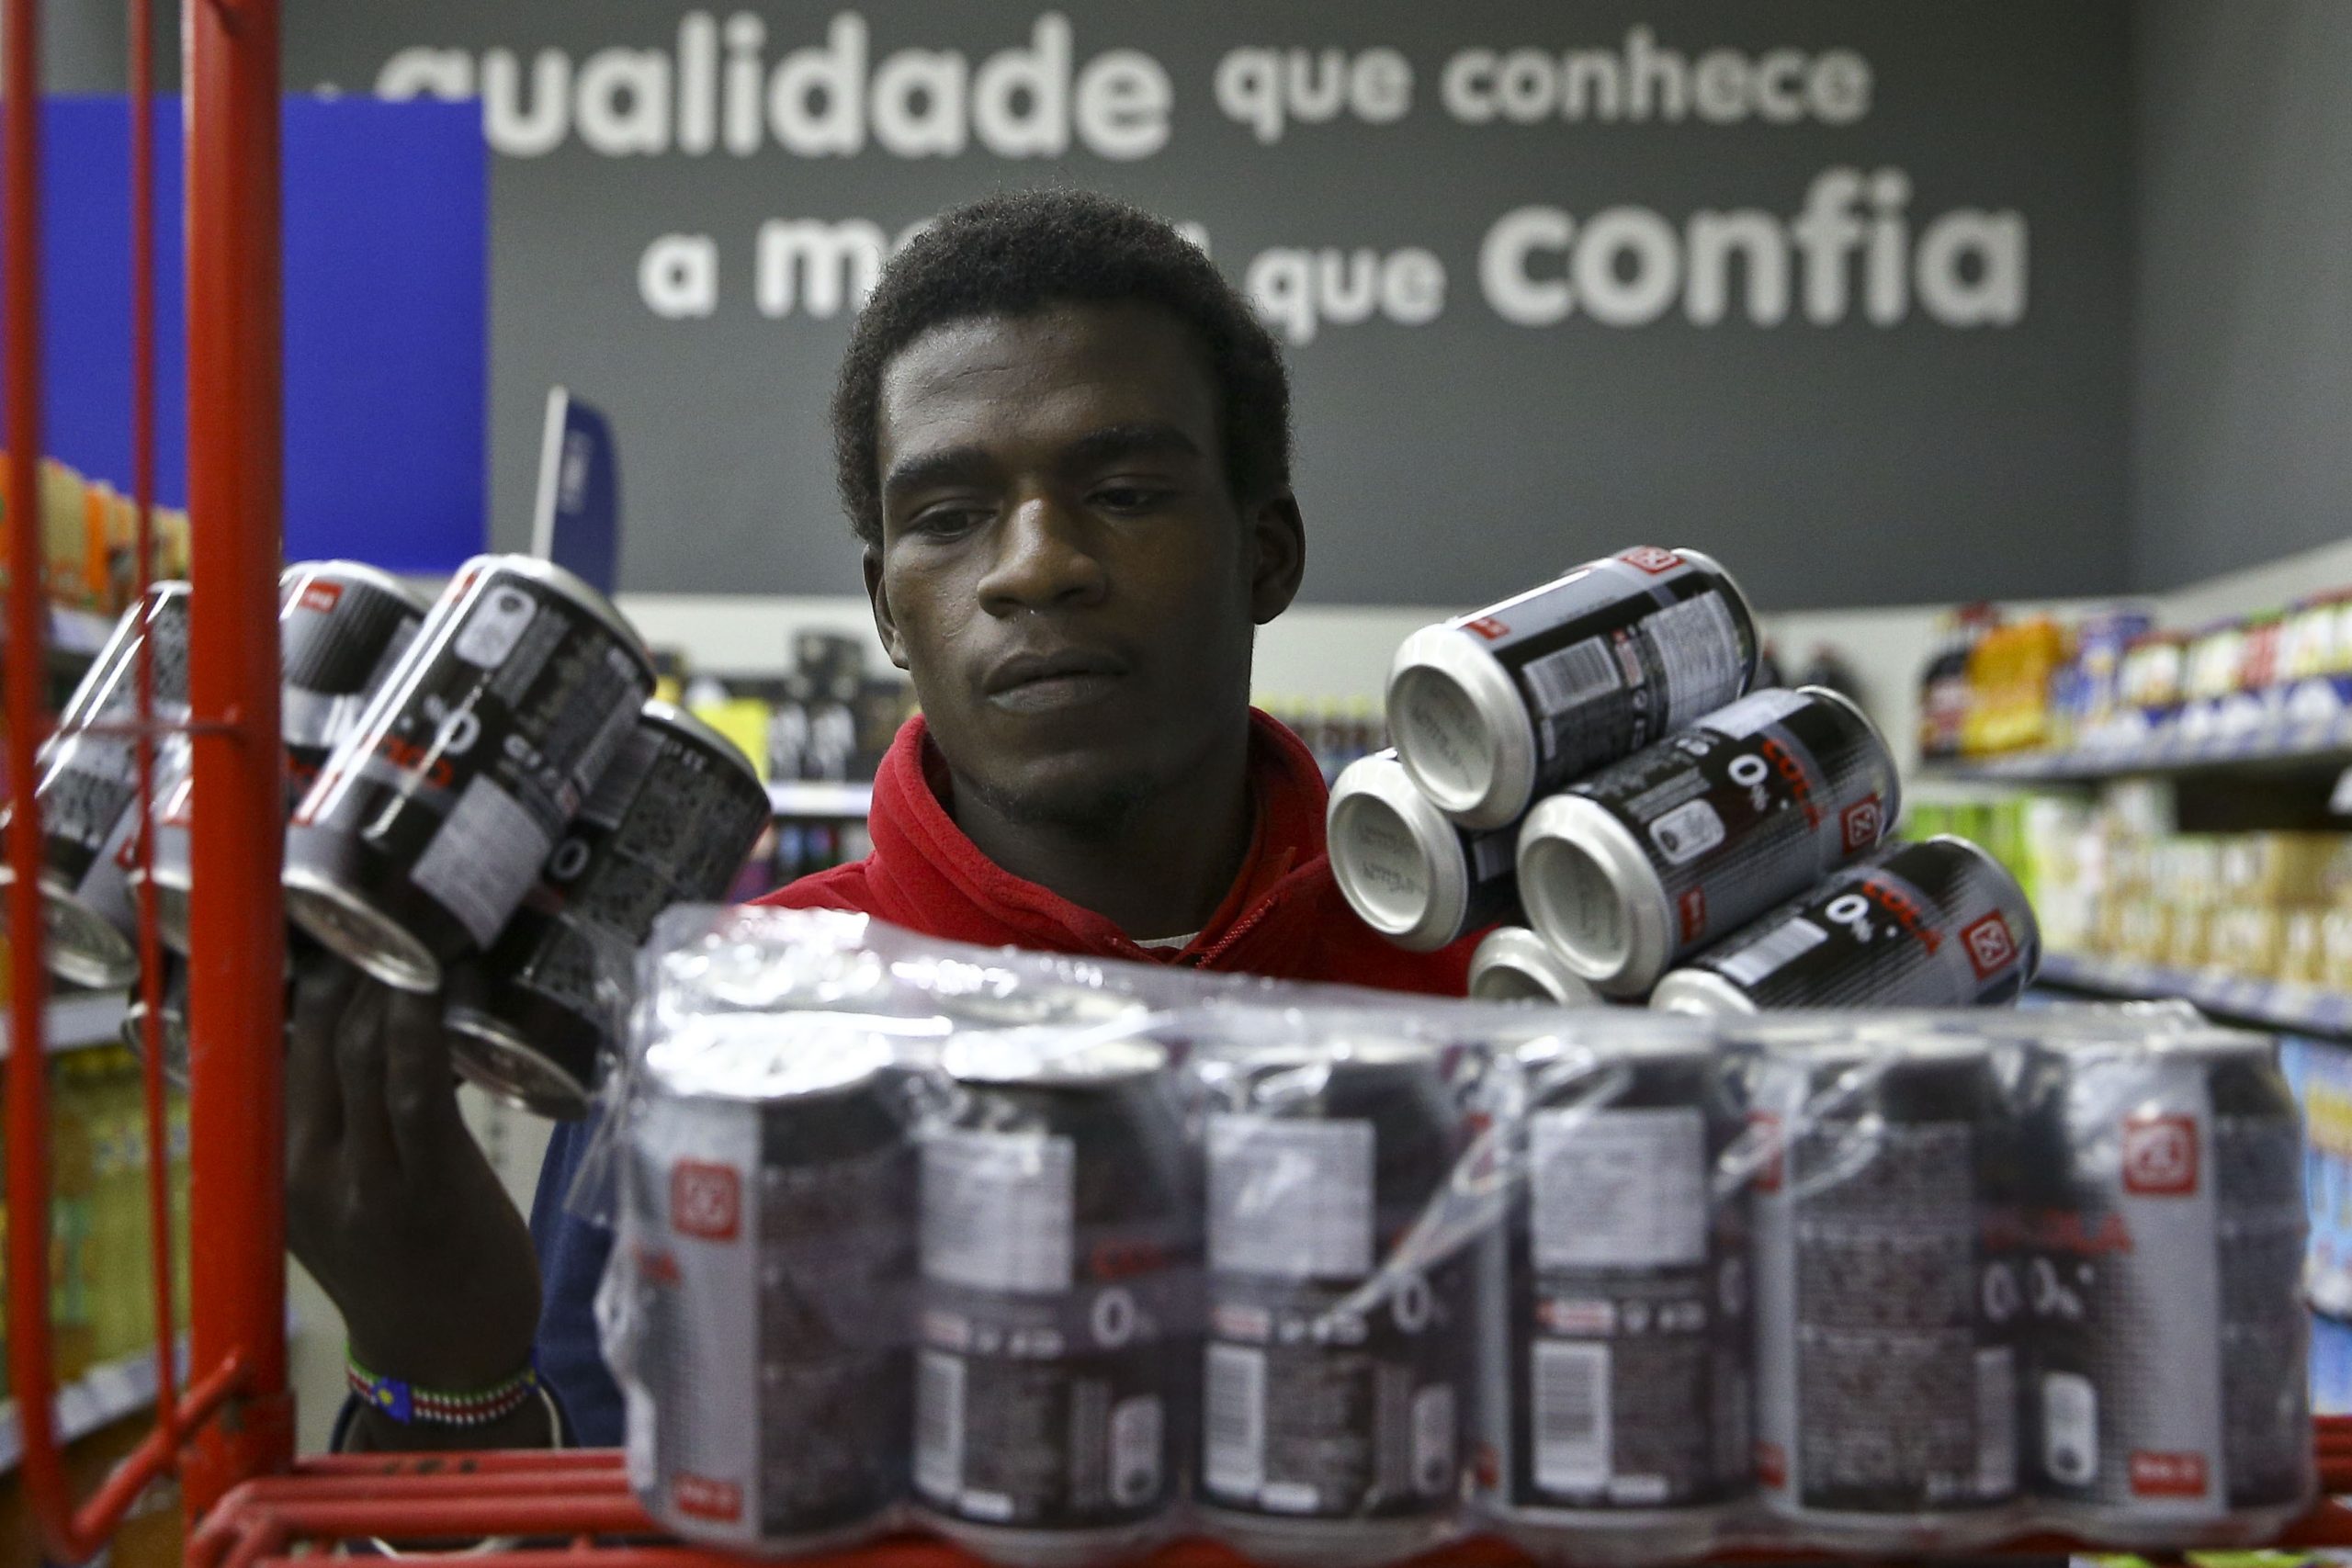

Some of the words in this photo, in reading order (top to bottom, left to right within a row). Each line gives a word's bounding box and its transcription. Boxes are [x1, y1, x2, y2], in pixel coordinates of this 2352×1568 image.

[1214, 46, 1415, 145] que
[1441, 25, 1873, 125] conhece
[639, 233, 719, 318] a
[1247, 245, 1447, 346] que
[1478, 167, 2028, 327] confia
